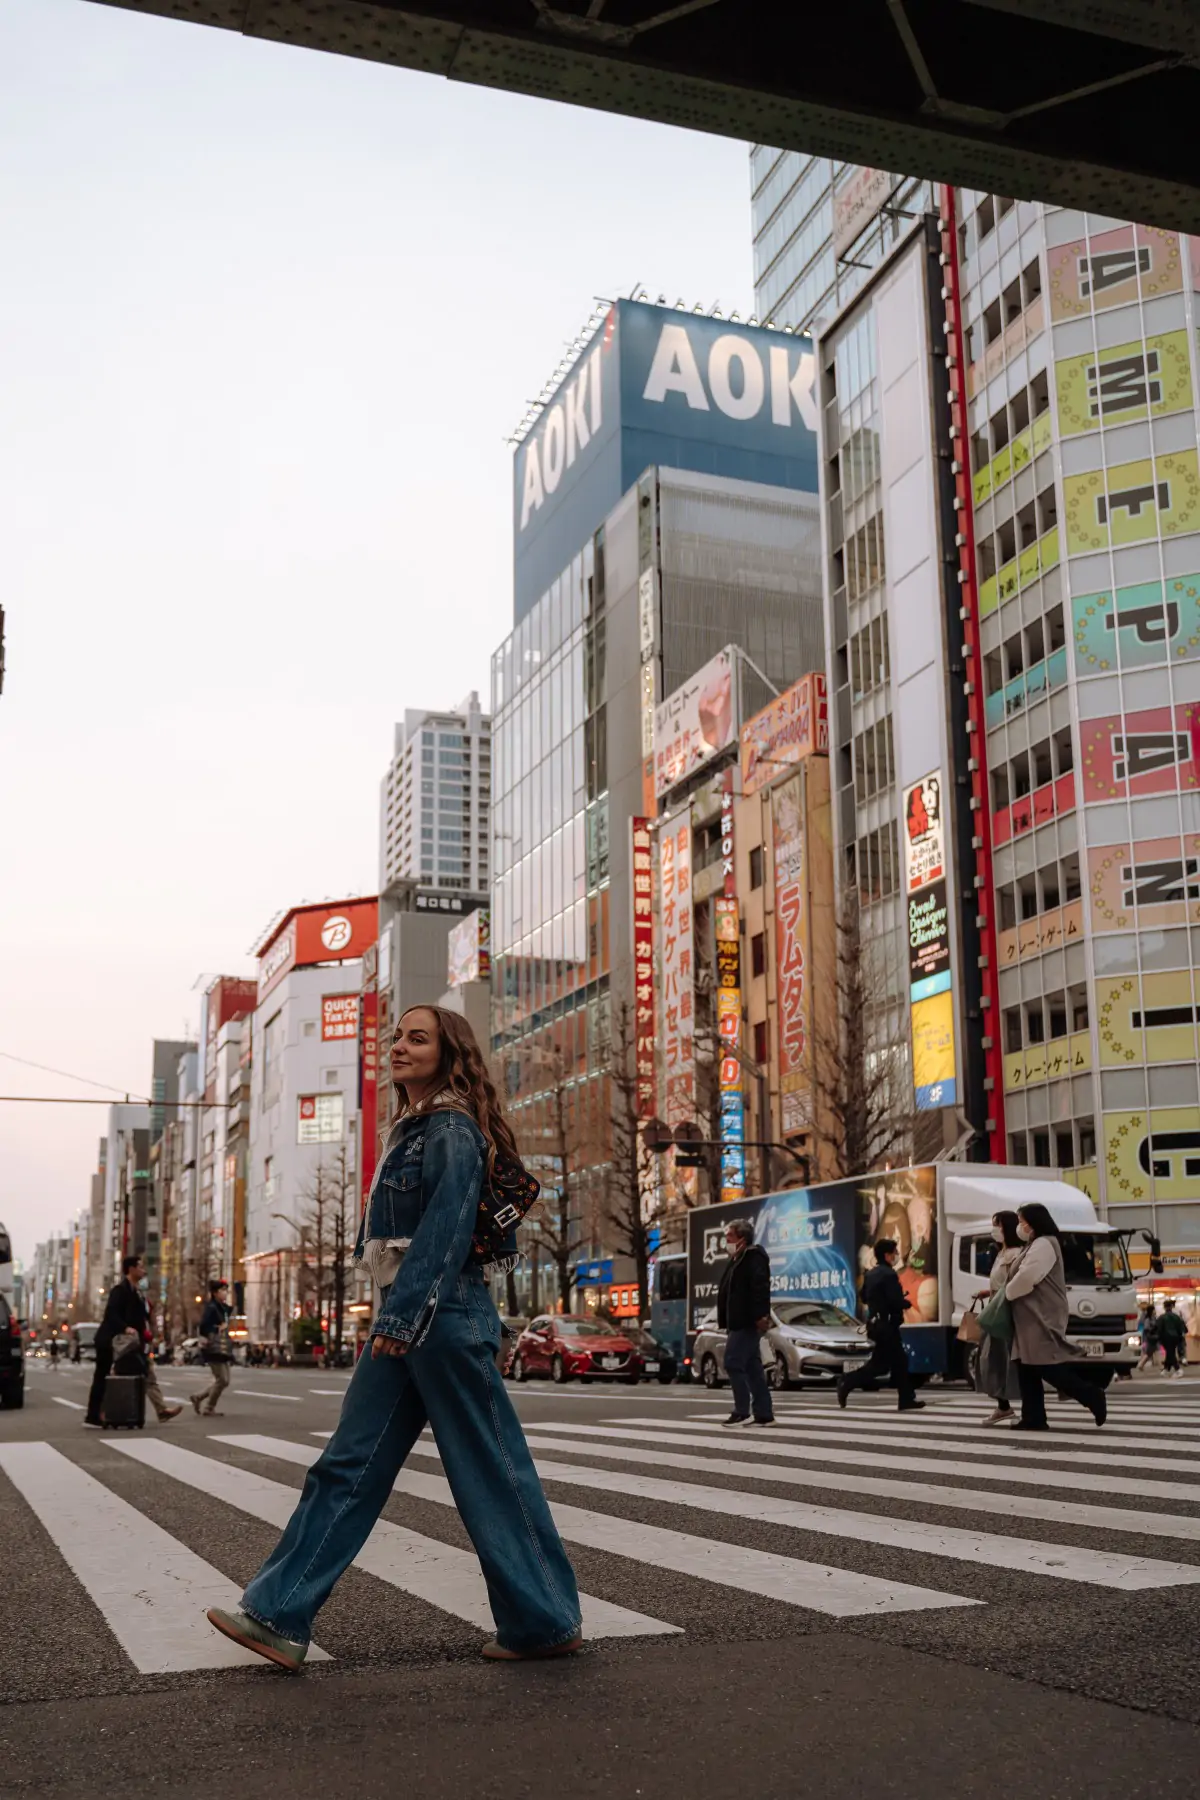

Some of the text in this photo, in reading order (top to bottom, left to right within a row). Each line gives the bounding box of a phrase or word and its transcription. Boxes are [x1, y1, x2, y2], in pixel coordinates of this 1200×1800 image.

[643, 323, 818, 432] AOK
[520, 345, 602, 532] AOKI
[1006, 920, 1077, 960] クレーンゲーム
[780, 882, 805, 1067] ラムタラ
[324, 1012, 342, 1023] Tax
[324, 1022, 357, 1038] 快速免
[1013, 1051, 1085, 1084] クレーンゲーム
